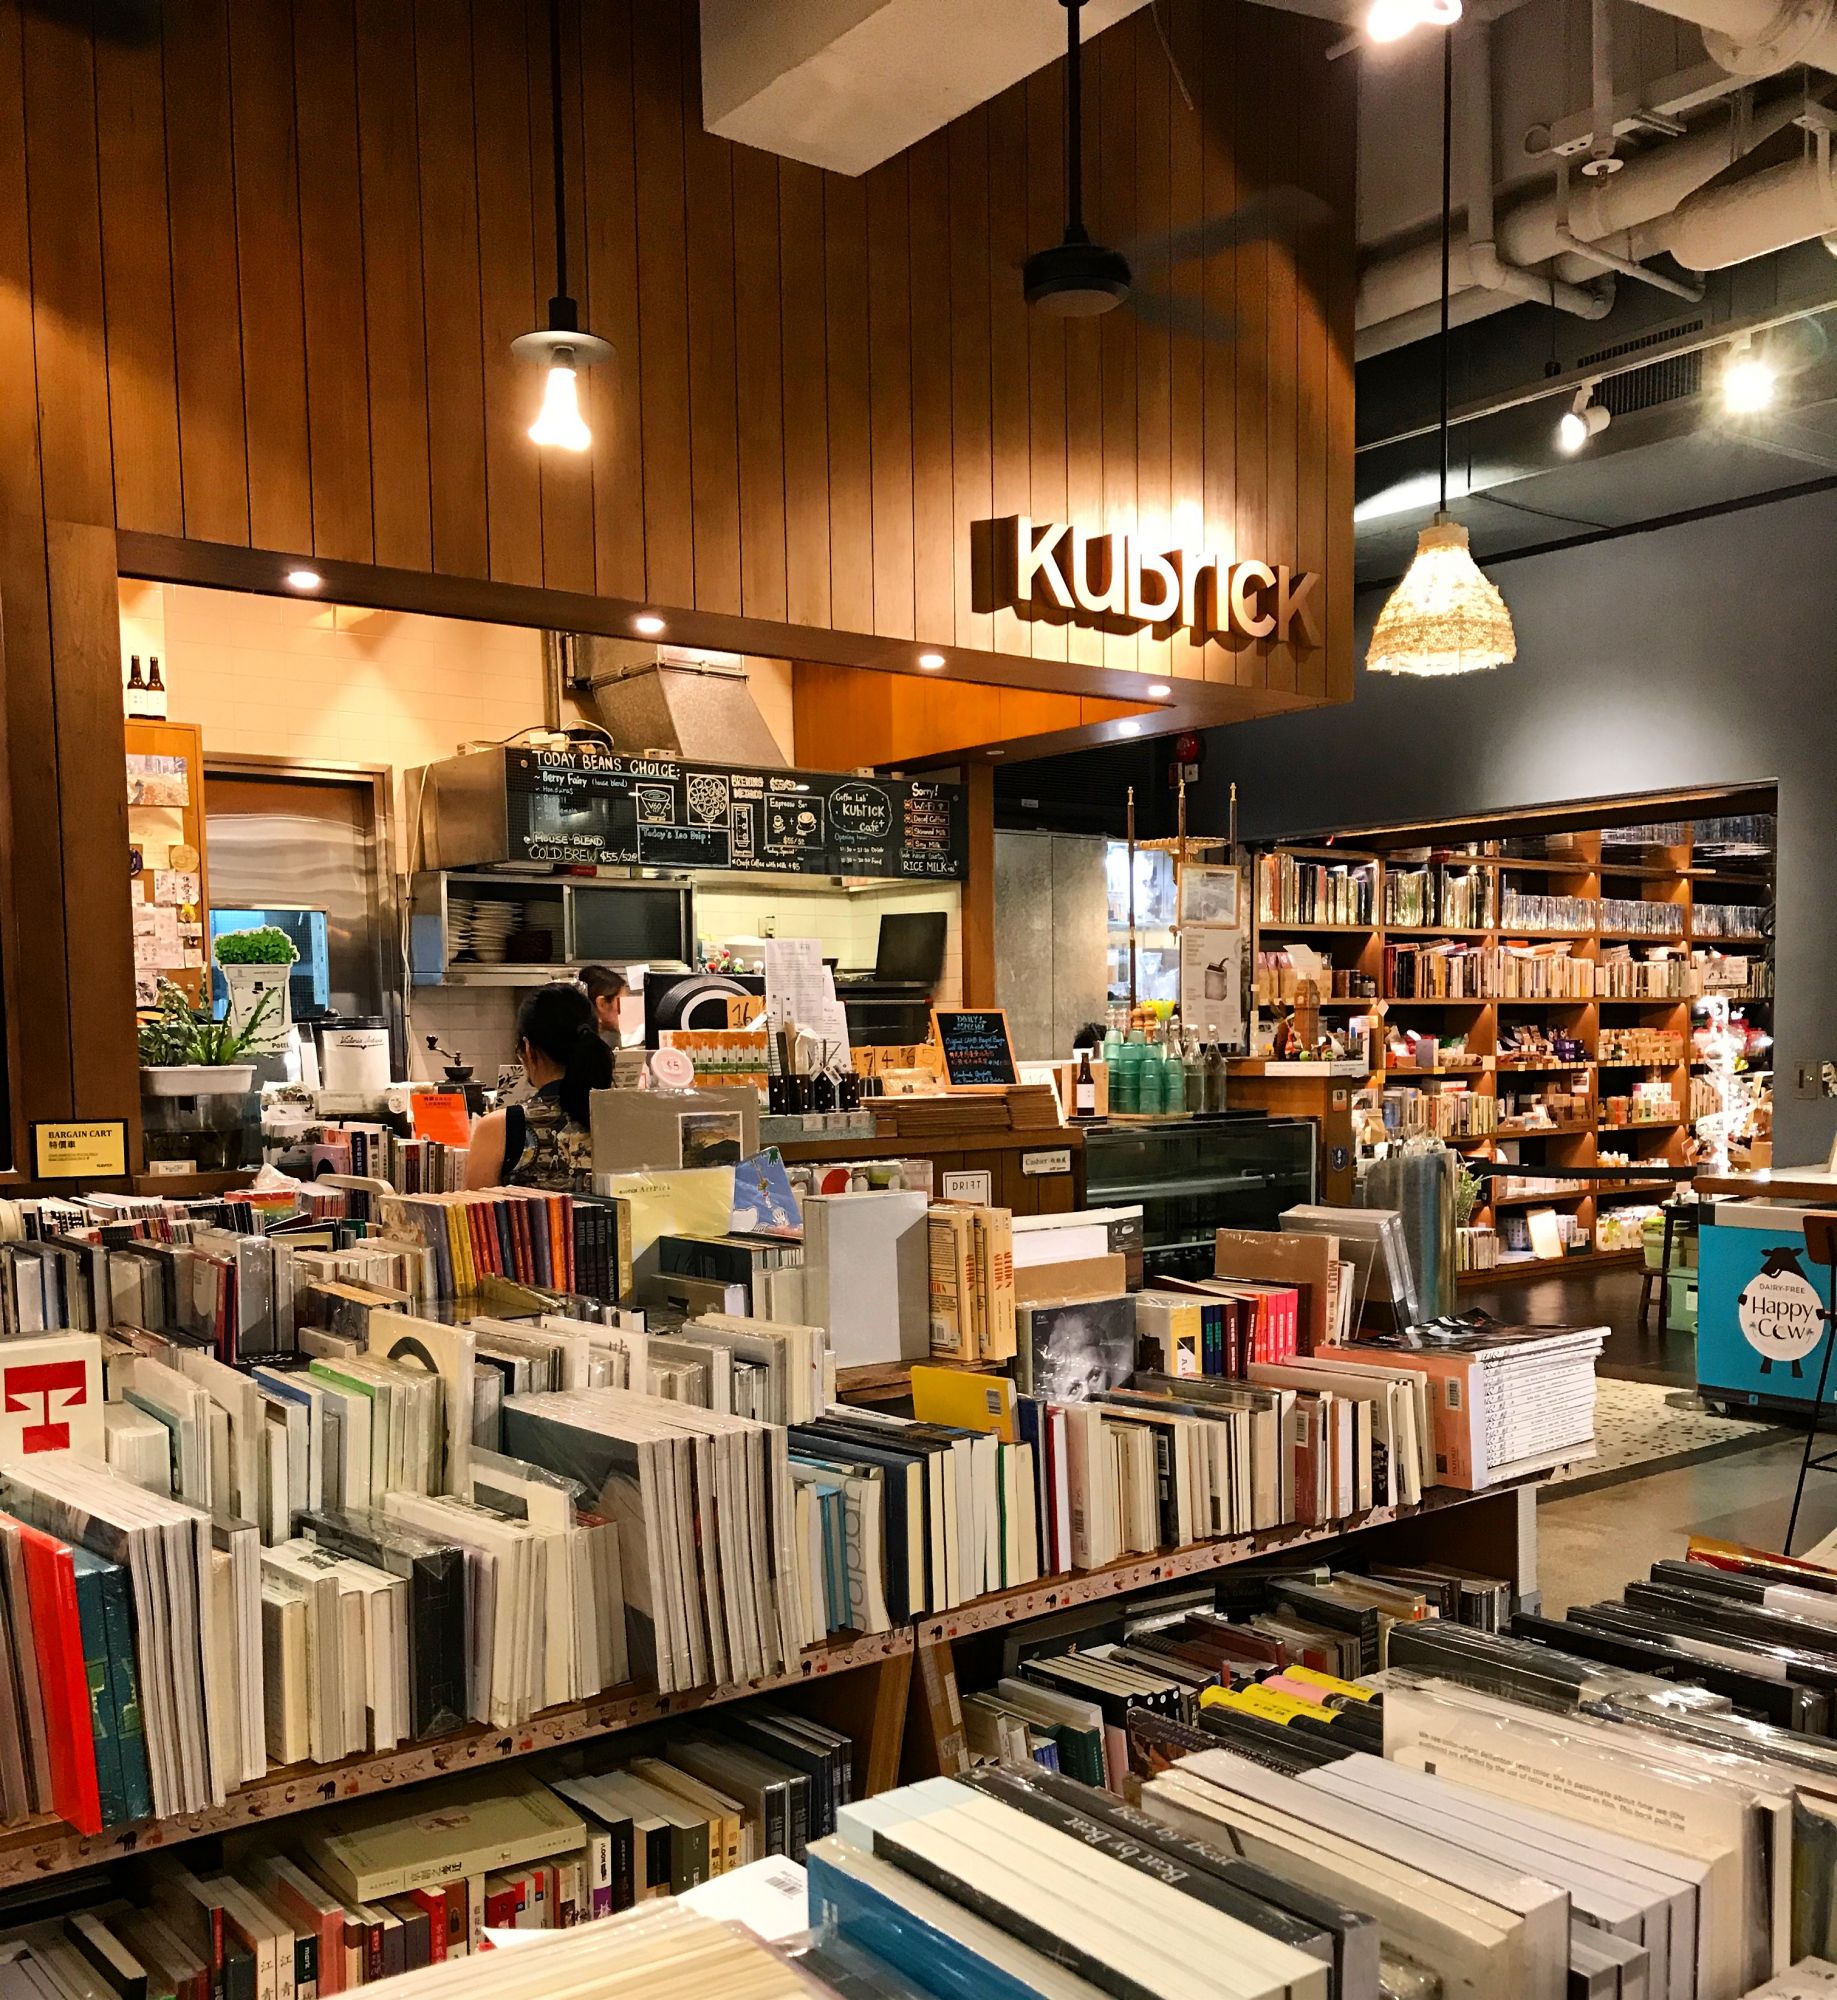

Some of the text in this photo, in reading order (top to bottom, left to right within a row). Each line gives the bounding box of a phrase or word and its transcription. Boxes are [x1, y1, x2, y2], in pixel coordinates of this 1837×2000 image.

[532, 750, 680, 777] TODAY BEANS CHOICE:
[542, 770, 565, 786] Berry
[567, 773, 587, 788] Fairy
[911, 782, 939, 799] Sorry!
[641, 827, 672, 840] Today's
[529, 844, 563, 860] COLD
[564, 846, 598, 863] BREW
[903, 861, 924, 871] RICE
[926, 862, 948, 872] MILK
[48, 1129, 112, 1139] BARGAIN CART
[1327, 1259, 1339, 1294] MUJI
[1759, 1282, 1806, 1295] DAIRY-FREE
[1751, 1296, 1815, 1323] Happy
